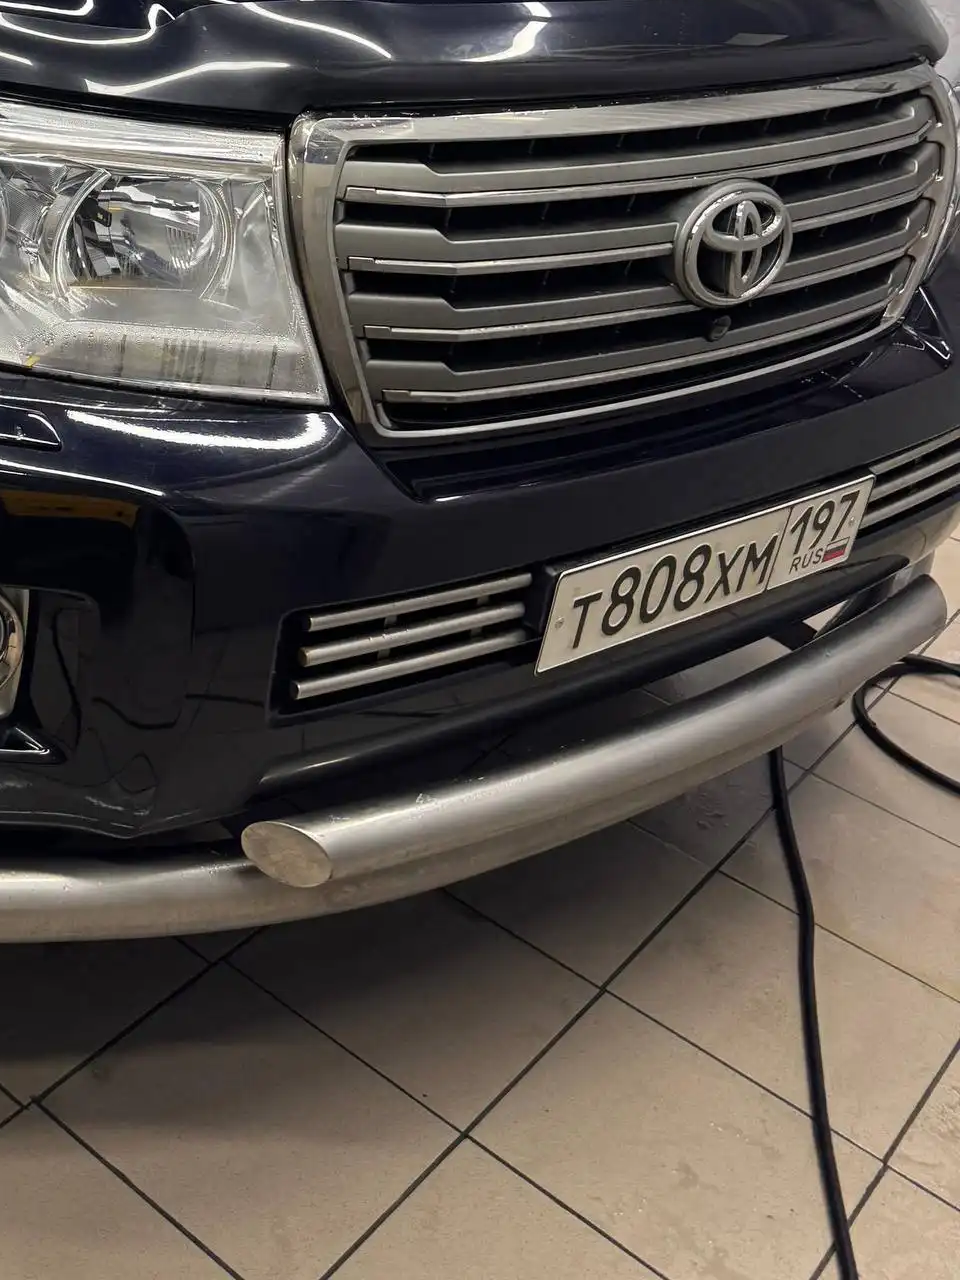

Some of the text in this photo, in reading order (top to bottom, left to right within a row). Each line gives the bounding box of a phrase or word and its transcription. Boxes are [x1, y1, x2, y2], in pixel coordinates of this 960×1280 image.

[572, 489, 861, 650] Т808ХМ 197
[788, 547, 824, 575] RUS
